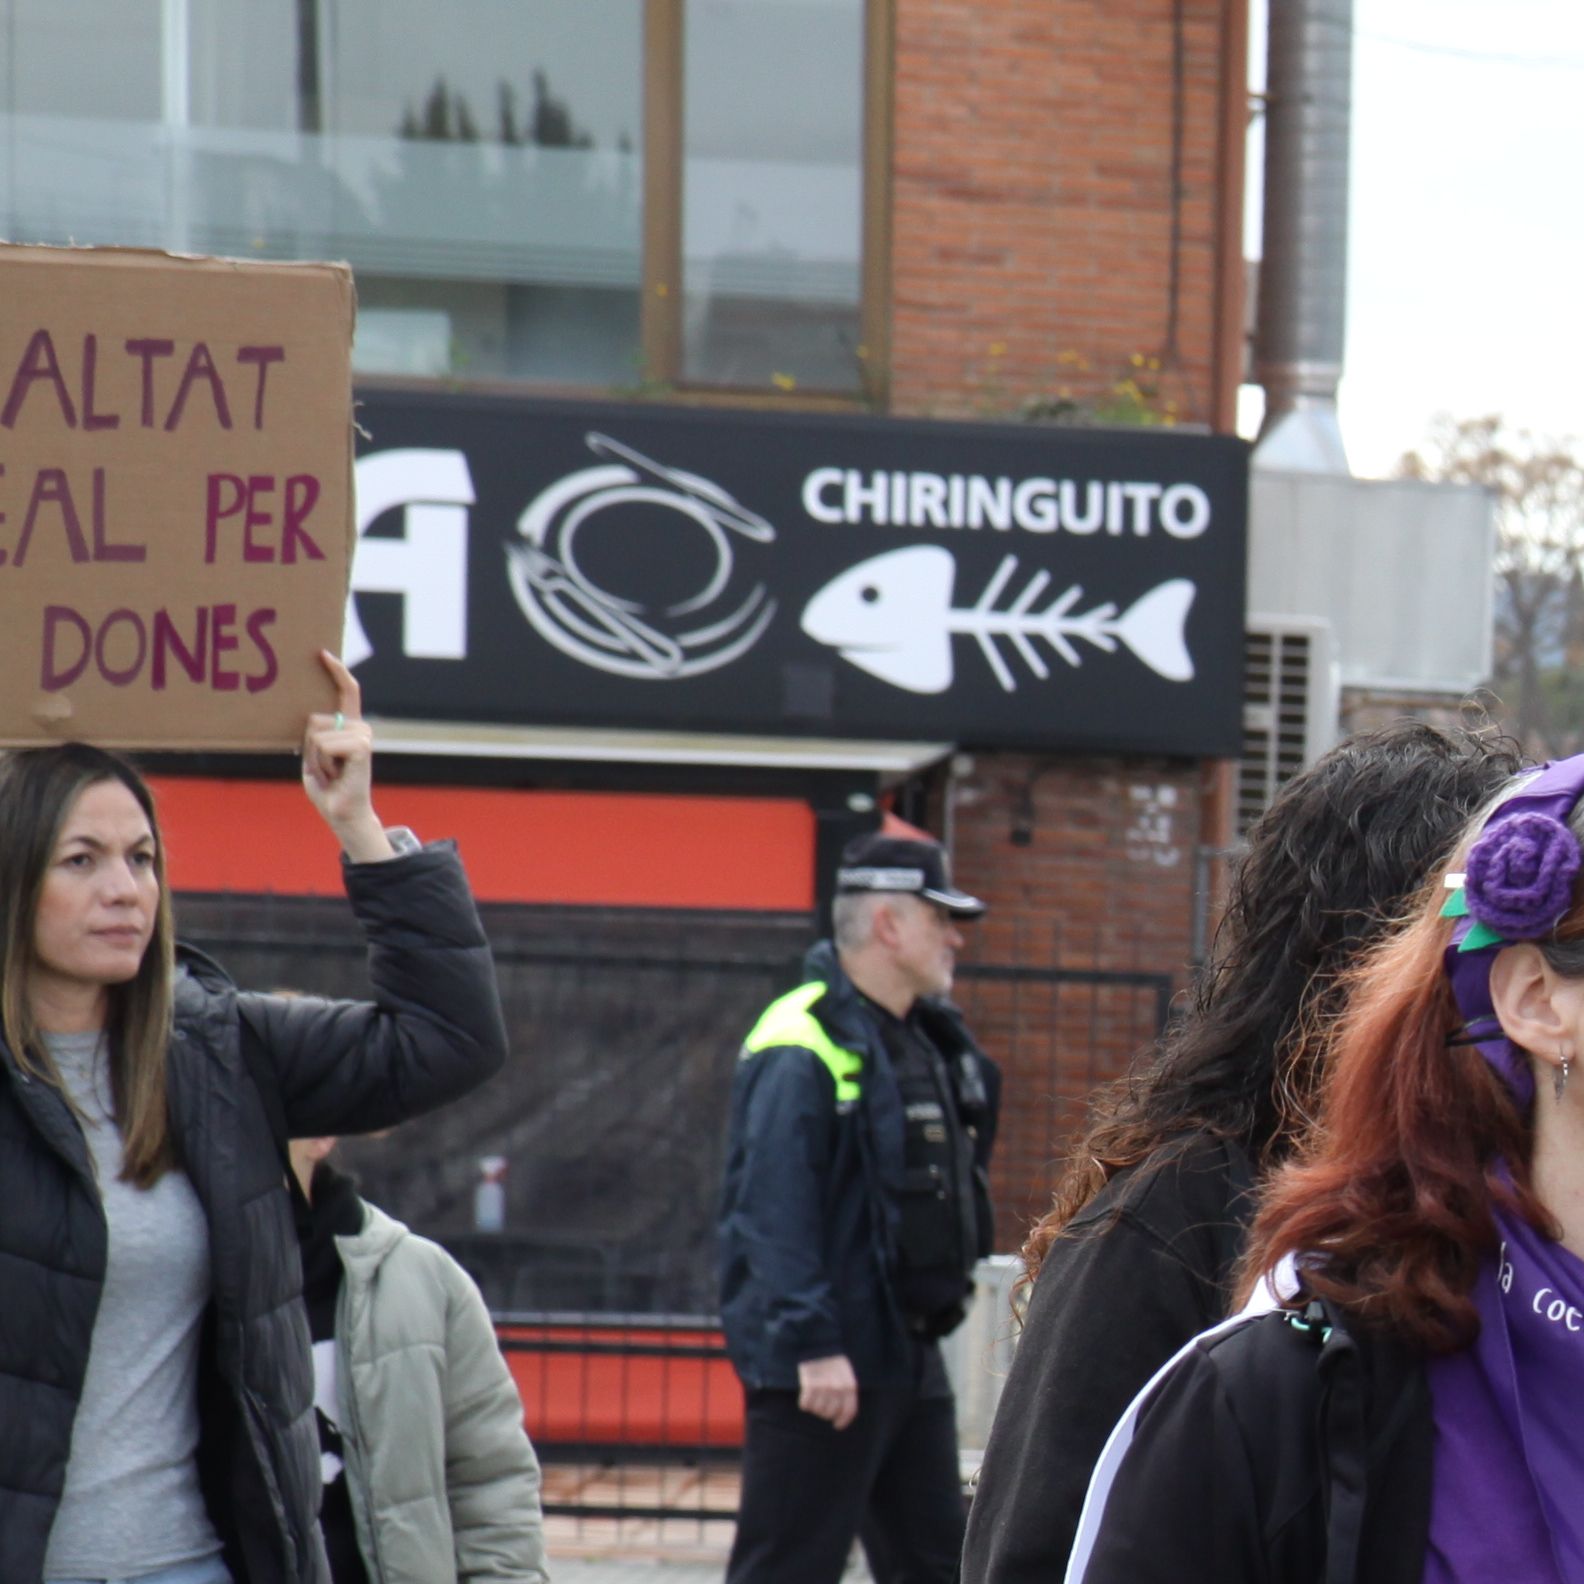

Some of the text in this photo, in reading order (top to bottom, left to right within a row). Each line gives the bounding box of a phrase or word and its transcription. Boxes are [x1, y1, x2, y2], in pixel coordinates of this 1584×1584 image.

[0, 329, 285, 432] ALTAT
[0, 463, 326, 567] AL PER
[802, 467, 1211, 539] CHIRINGUITO
[41, 603, 279, 693] DONES
